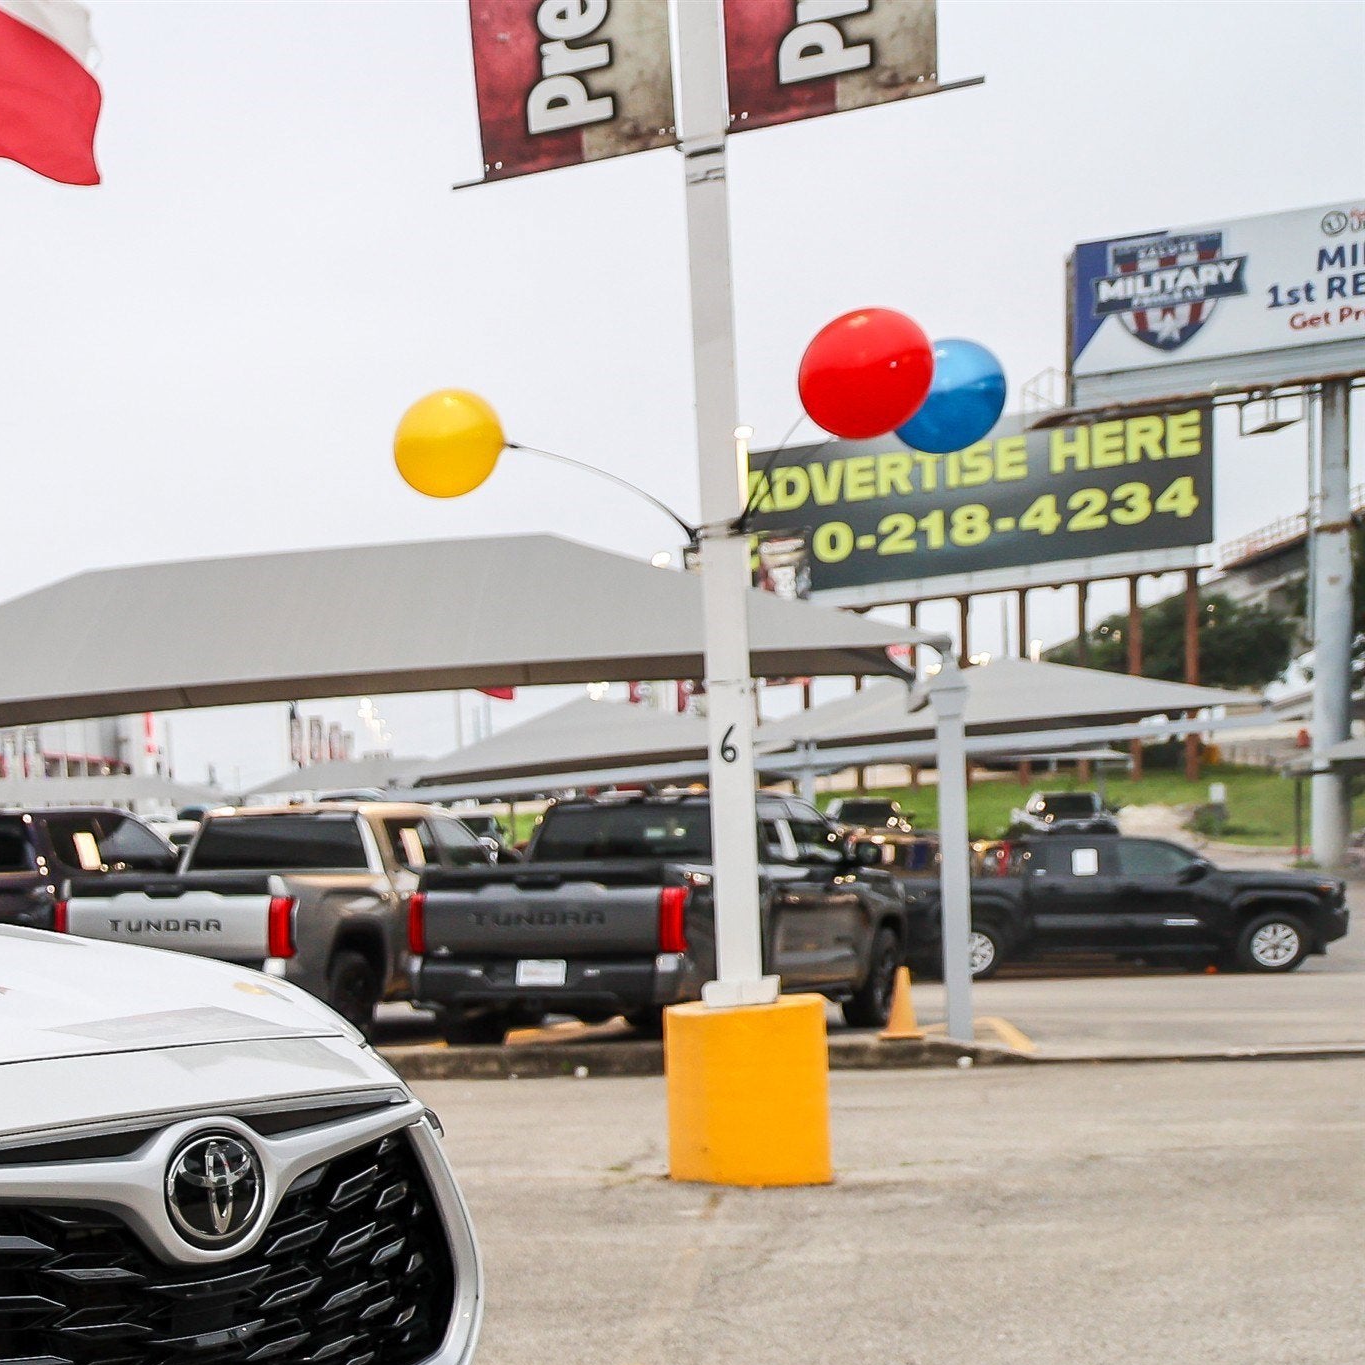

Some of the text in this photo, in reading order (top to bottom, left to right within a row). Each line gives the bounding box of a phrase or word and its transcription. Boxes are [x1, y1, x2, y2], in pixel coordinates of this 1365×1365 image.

[1098, 259, 1240, 301] MILITARY
[1267, 284, 1315, 309] 1st
[1289, 309, 1330, 331] Get
[1048, 407, 1203, 476] HERE
[720, 724, 737, 763] 6
[108, 918, 222, 933] TUNDRA
[472, 910, 607, 927] TUNDRA
